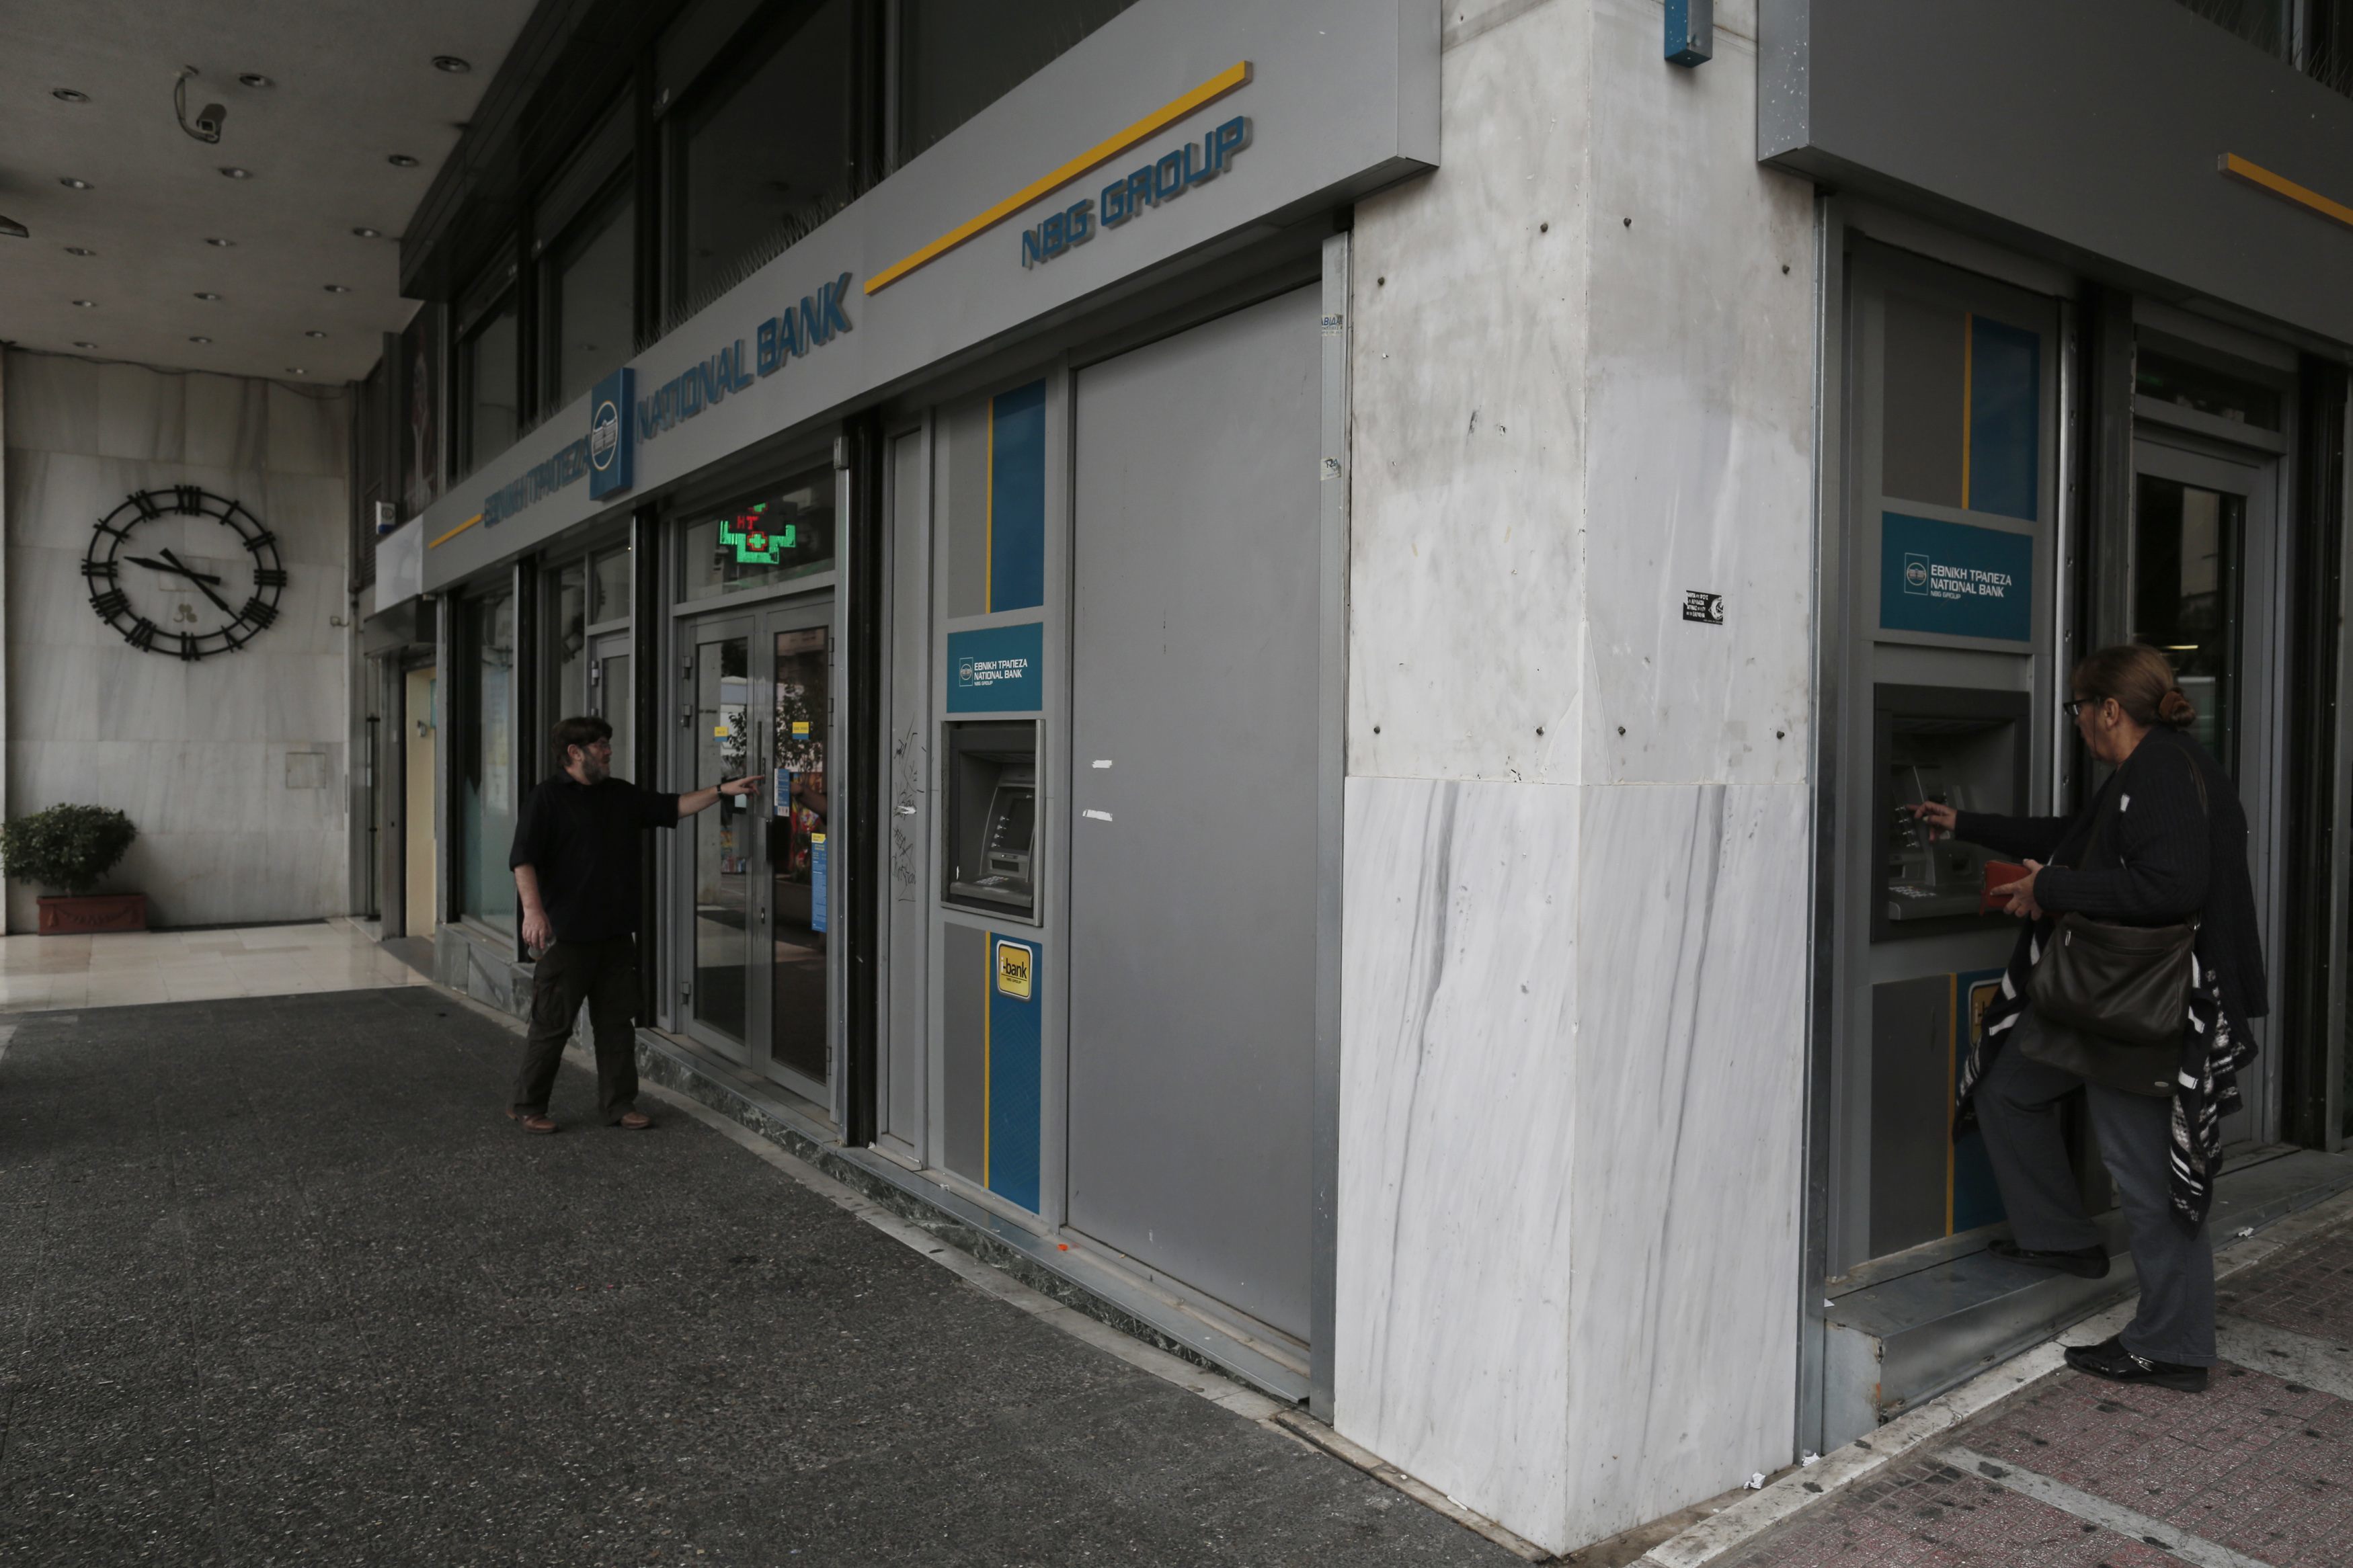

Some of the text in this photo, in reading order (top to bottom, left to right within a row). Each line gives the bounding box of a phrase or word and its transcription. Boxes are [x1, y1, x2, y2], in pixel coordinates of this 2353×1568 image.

[1022, 116, 1252, 270] NBG GROUP
[637, 272, 852, 442] NATIONAL BANK
[1931, 564, 2012, 586] ΕΘΝΙΚΗ ΤΡΑΠΕΖΑ
[1931, 577, 2004, 597] NATIONAL BANK
[1942, 591, 1961, 600] GROUP
[974, 659, 1027, 671] ΕΘΝΙΚΗ ΤΡΑΠΕΖΑ
[974, 669, 1022, 680] NATIONAL BANK
[1001, 957, 1027, 979] i-bank
